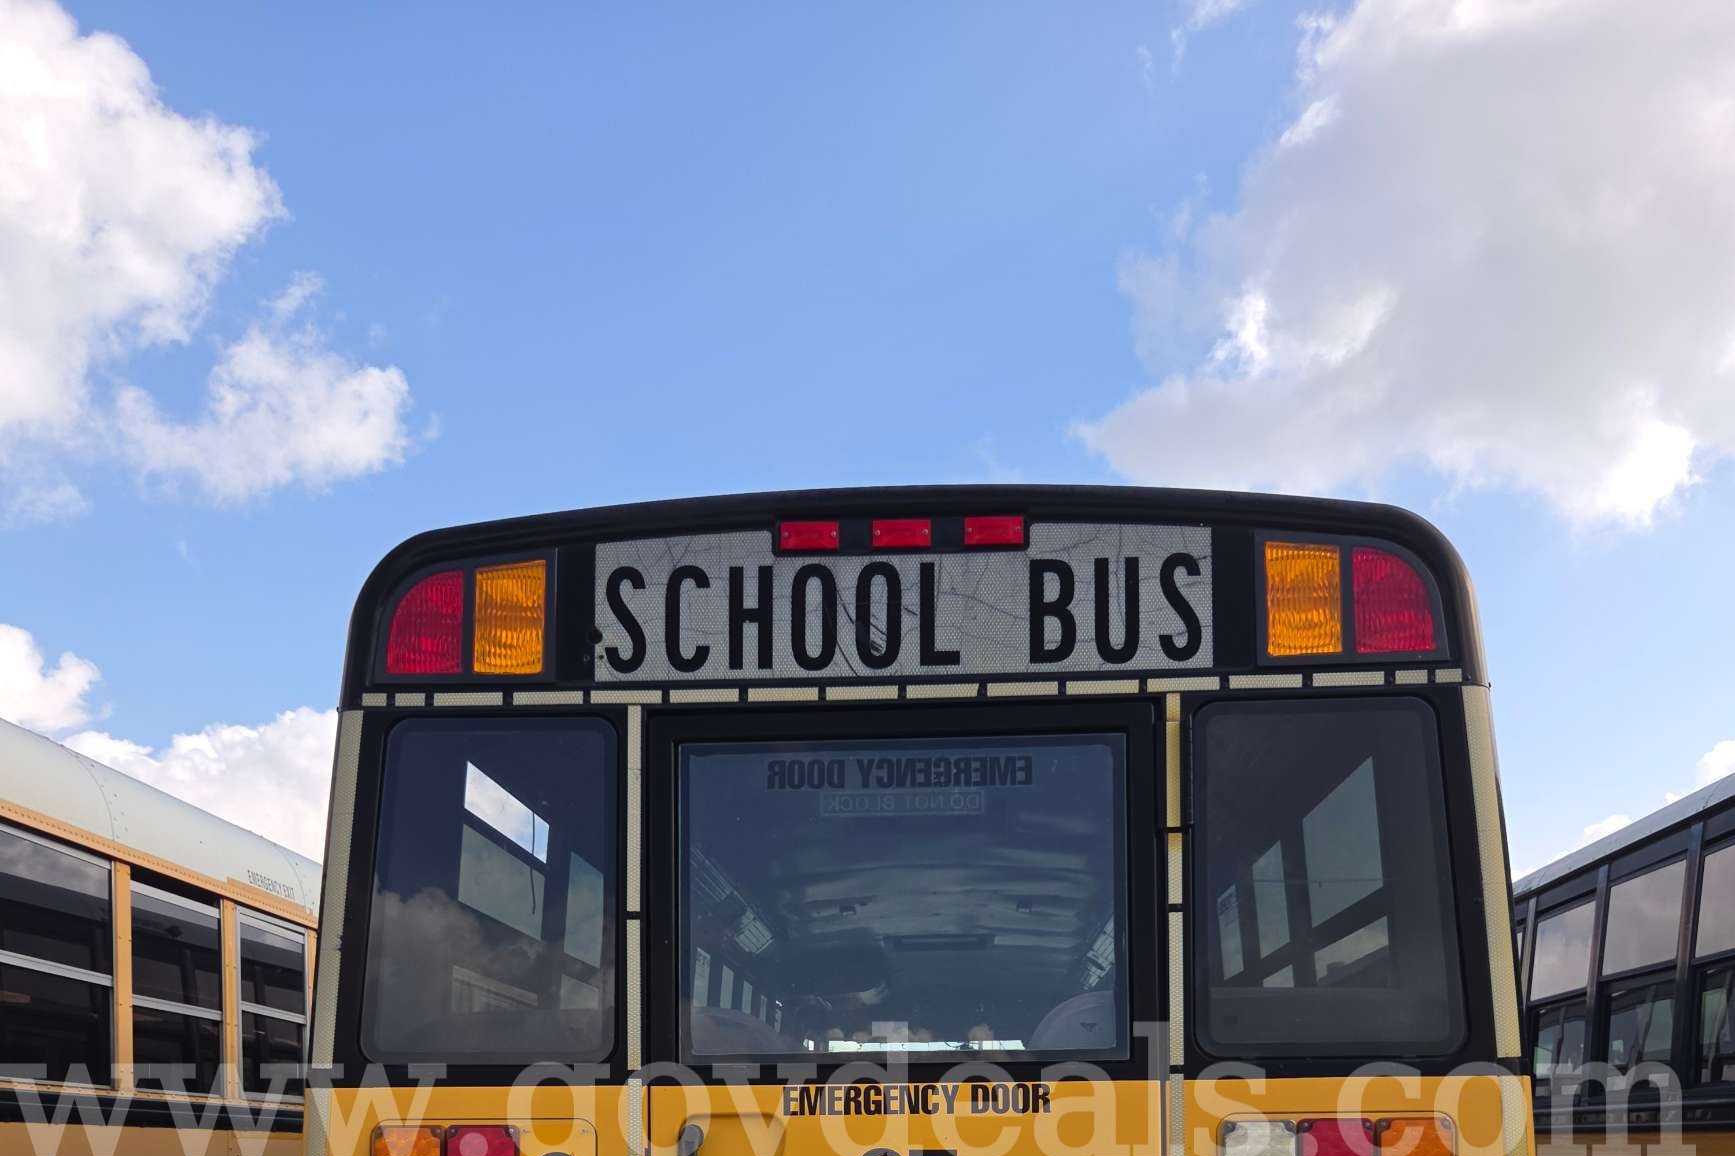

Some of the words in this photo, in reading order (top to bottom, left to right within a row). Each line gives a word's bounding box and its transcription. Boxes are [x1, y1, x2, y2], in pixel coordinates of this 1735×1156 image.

[605, 561, 960, 673] SCHOOL
[1029, 552, 1203, 664] BUS
[783, 1084, 960, 1116] EMERGENCY
[970, 1082, 1052, 1114] DOOR
